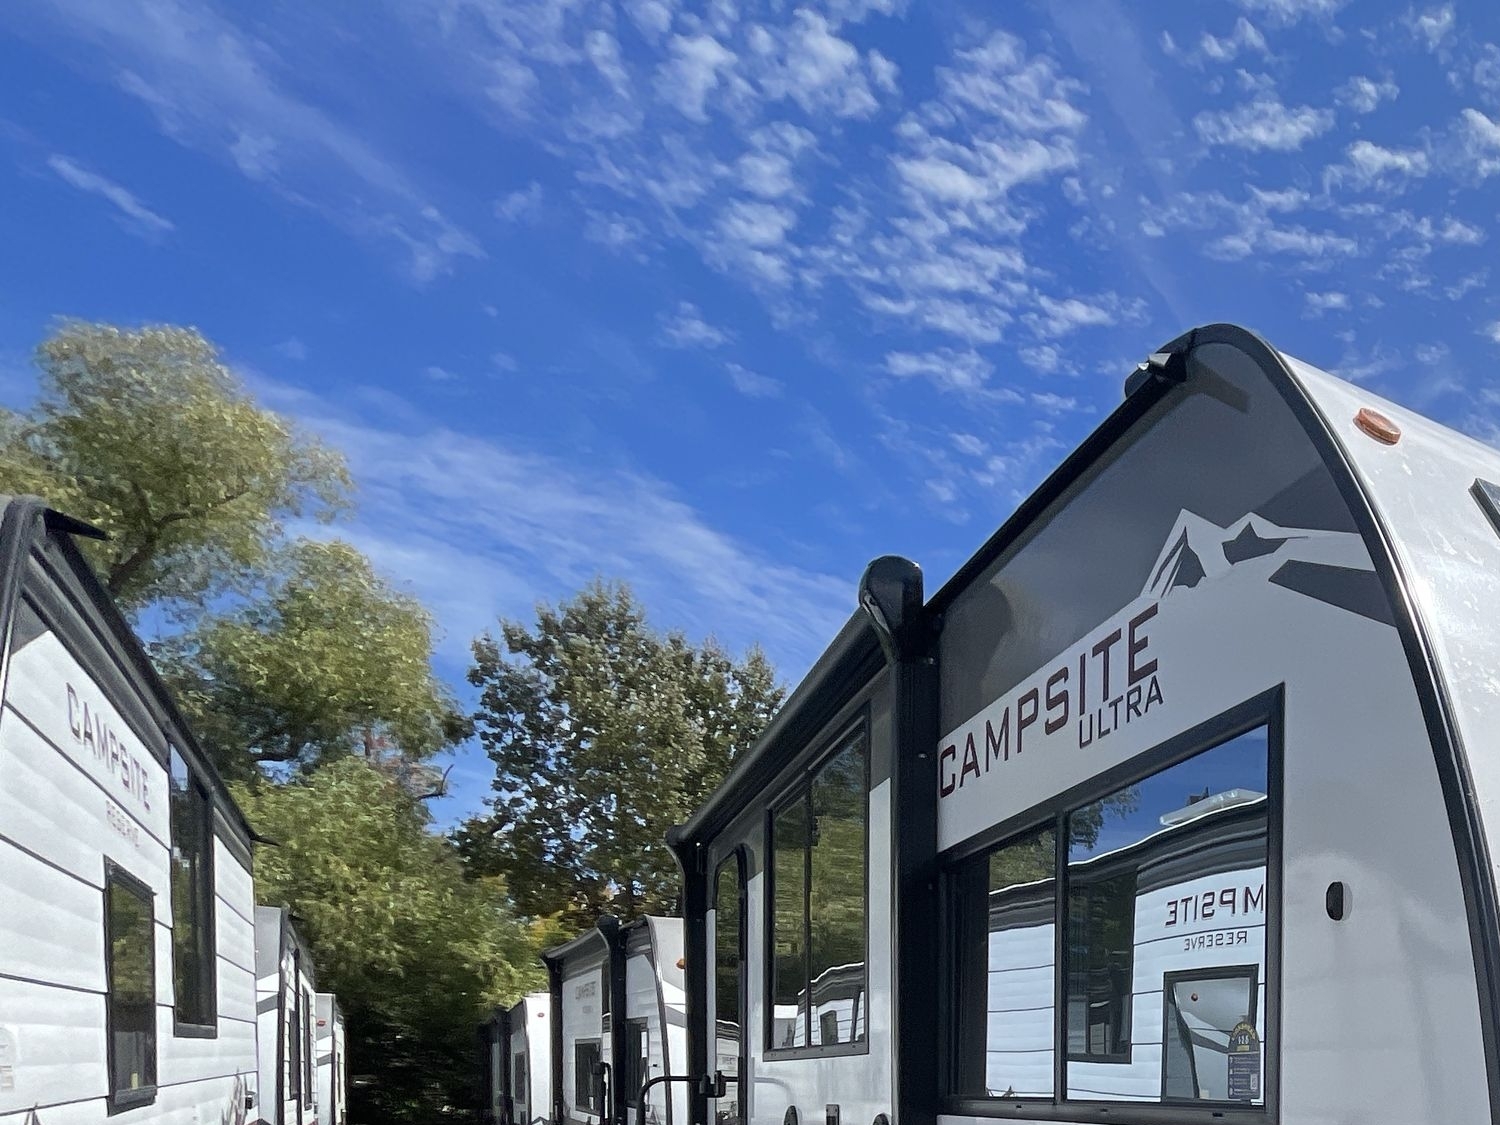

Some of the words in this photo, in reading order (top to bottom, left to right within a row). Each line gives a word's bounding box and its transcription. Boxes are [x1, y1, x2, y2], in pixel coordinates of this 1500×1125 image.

[65, 681, 151, 813] CAMPSITE
[939, 602, 1158, 799] CAMPSITE
[1078, 674, 1164, 750] ULTRA
